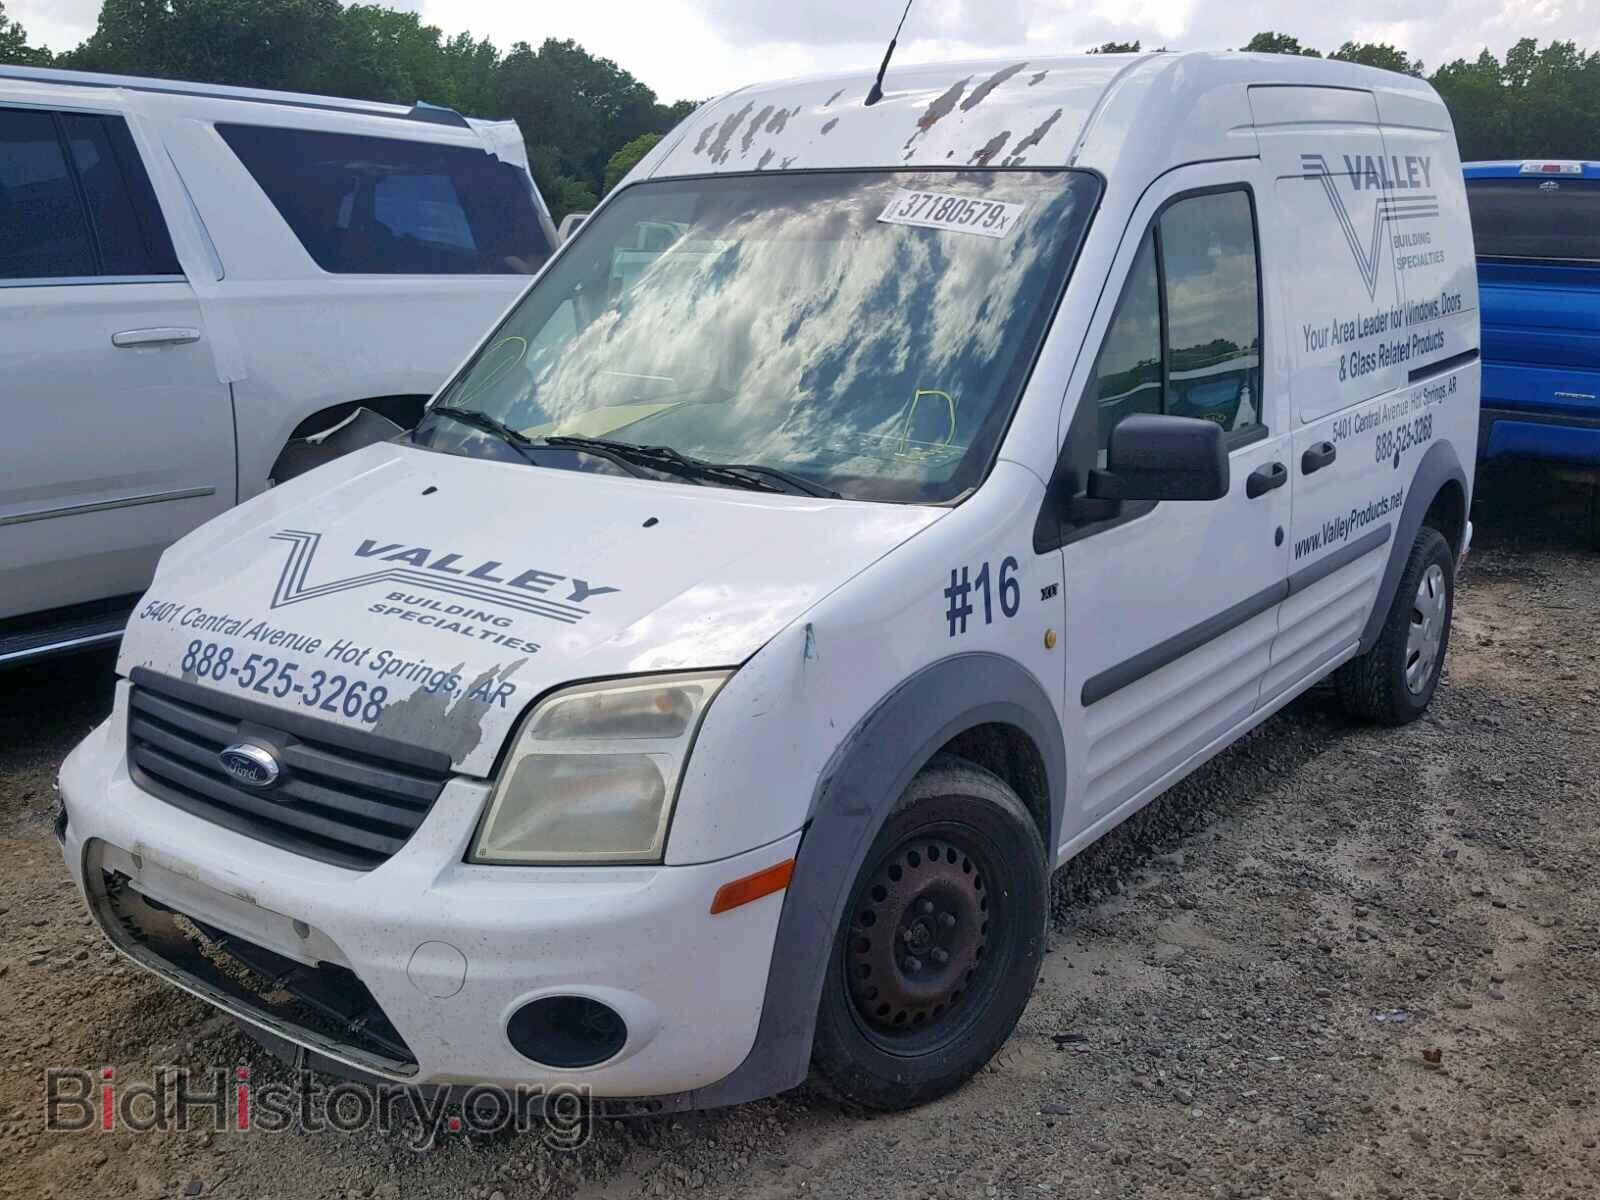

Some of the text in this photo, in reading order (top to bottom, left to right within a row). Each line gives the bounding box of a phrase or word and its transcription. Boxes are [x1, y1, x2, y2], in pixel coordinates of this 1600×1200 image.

[1343, 155, 1431, 190] VALLEY
[1393, 232, 1431, 248] BUILDING
[1396, 250, 1445, 270] SPECIALTIES
[1303, 323, 1328, 352] Your
[1331, 318, 1355, 346] Area
[1358, 308, 1389, 338] Leader
[1390, 307, 1403, 329] for
[1442, 292, 1462, 315] Doors
[1338, 329, 1444, 382] & Glass Related Products
[1332, 418, 1352, 443] 5401
[1354, 408, 1381, 434] Central
[1382, 399, 1409, 424] Avenue
[1447, 376, 1457, 397] AR
[1375, 413, 1433, 463] 888-525-3268
[1294, 485, 1404, 560] www.ValleyProducts.net
[354, 539, 622, 602] VALLEY
[944, 556, 1020, 637] #16
[368, 603, 542, 653] SPECIALTIES
[385, 591, 514, 627] BUILDING
[140, 600, 516, 708] 5401 Central Avenue Hot Springs, AR
[181, 639, 388, 723] 888-525-3268
[230, 758, 258, 780] Ford
